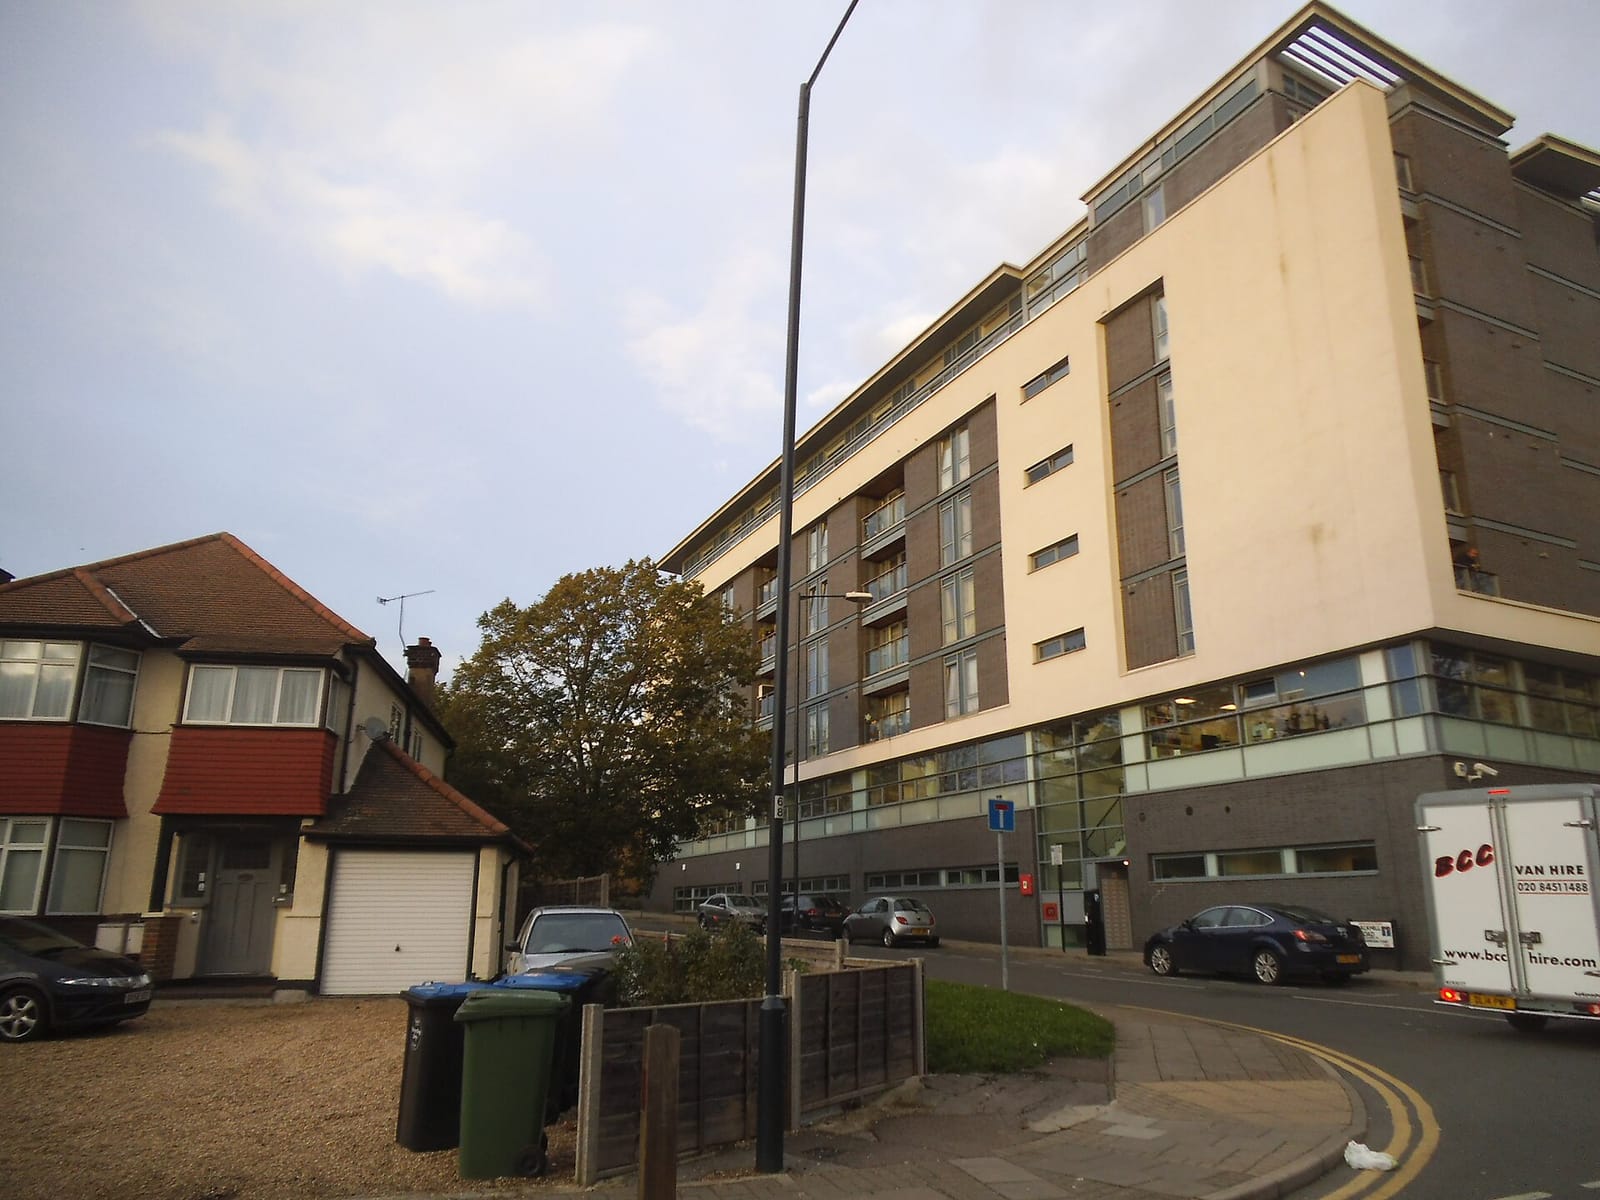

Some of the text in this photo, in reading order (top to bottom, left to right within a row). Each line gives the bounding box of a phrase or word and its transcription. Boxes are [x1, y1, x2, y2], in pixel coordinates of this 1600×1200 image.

[1435, 844, 1494, 878] BCC
[1515, 865, 1584, 875] VAN HIRE
[1517, 883, 1588, 892] 020 84511488
[1444, 949, 1596, 967] www.bcc hire.com
